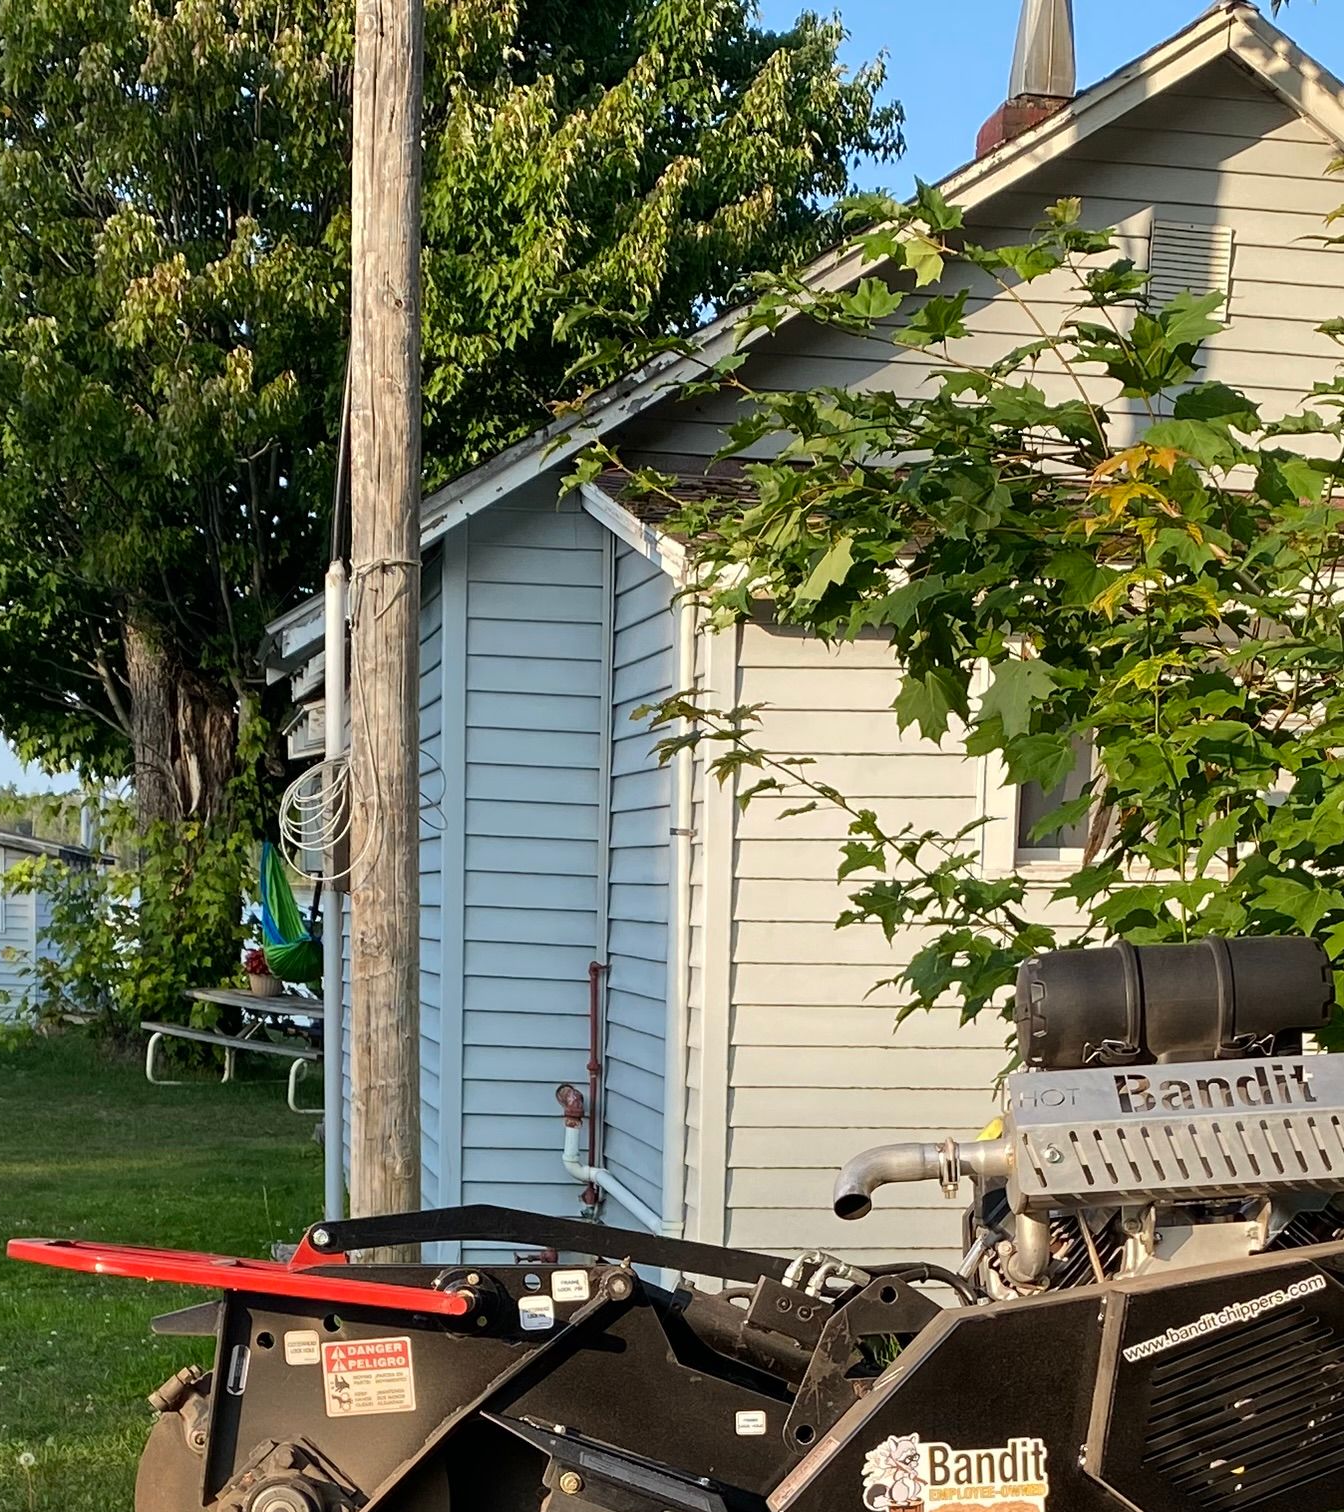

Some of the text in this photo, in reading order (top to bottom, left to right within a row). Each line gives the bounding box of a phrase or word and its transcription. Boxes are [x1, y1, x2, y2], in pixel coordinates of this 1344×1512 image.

[1019, 1087, 1080, 1107] HOT
[1113, 1064, 1317, 1113] Bandit
[1124, 1275, 1326, 1361] www.banditchippers.com
[347, 1343, 403, 1356] DANGER
[348, 1356, 406, 1370] PELIGRO
[928, 1441, 1044, 1486] Bandit
